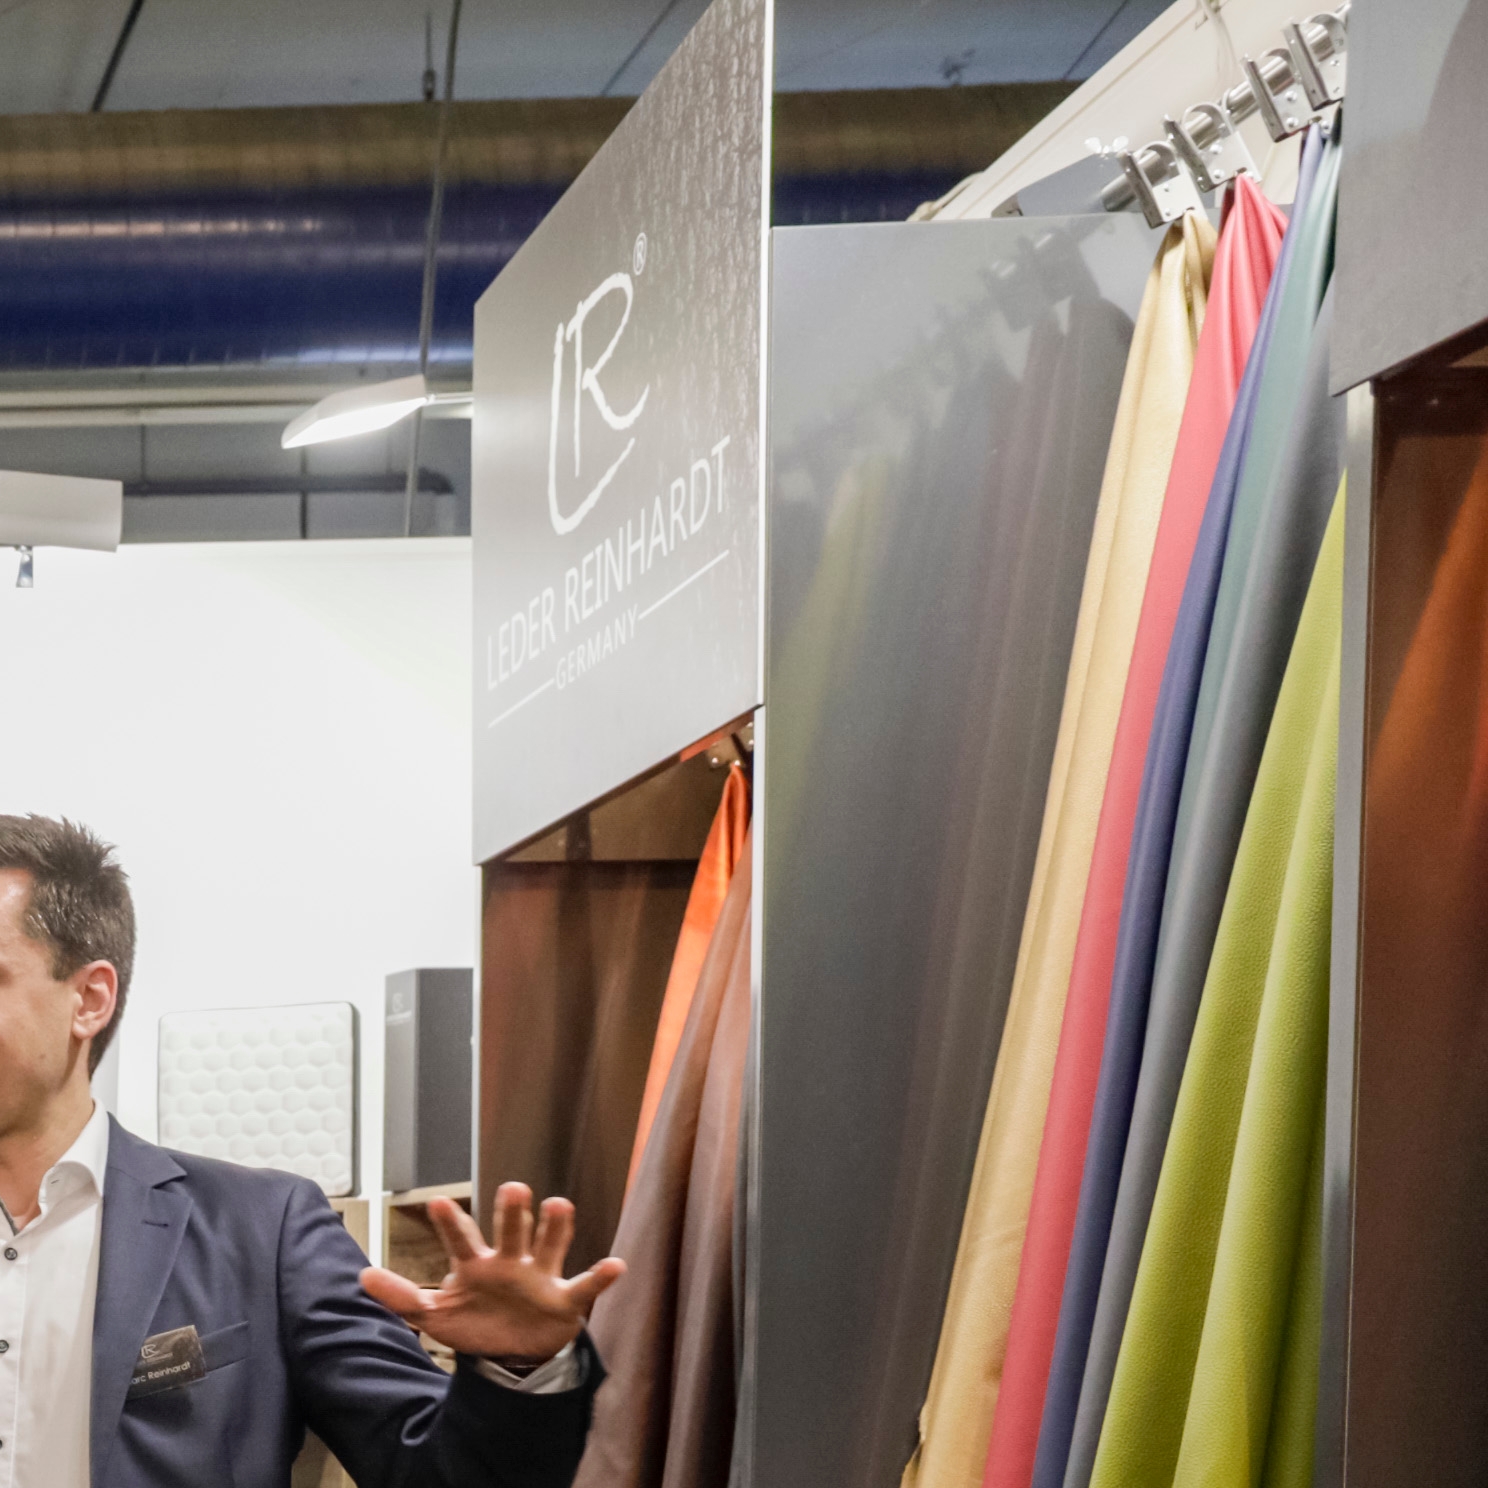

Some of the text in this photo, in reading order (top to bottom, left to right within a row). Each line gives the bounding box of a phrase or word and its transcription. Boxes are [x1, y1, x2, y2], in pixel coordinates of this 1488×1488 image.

[487, 435, 731, 691] LEDER REINHARDT
[556, 603, 639, 690] GERMANY
[131, 1361, 191, 1385] arc Reinhardt
